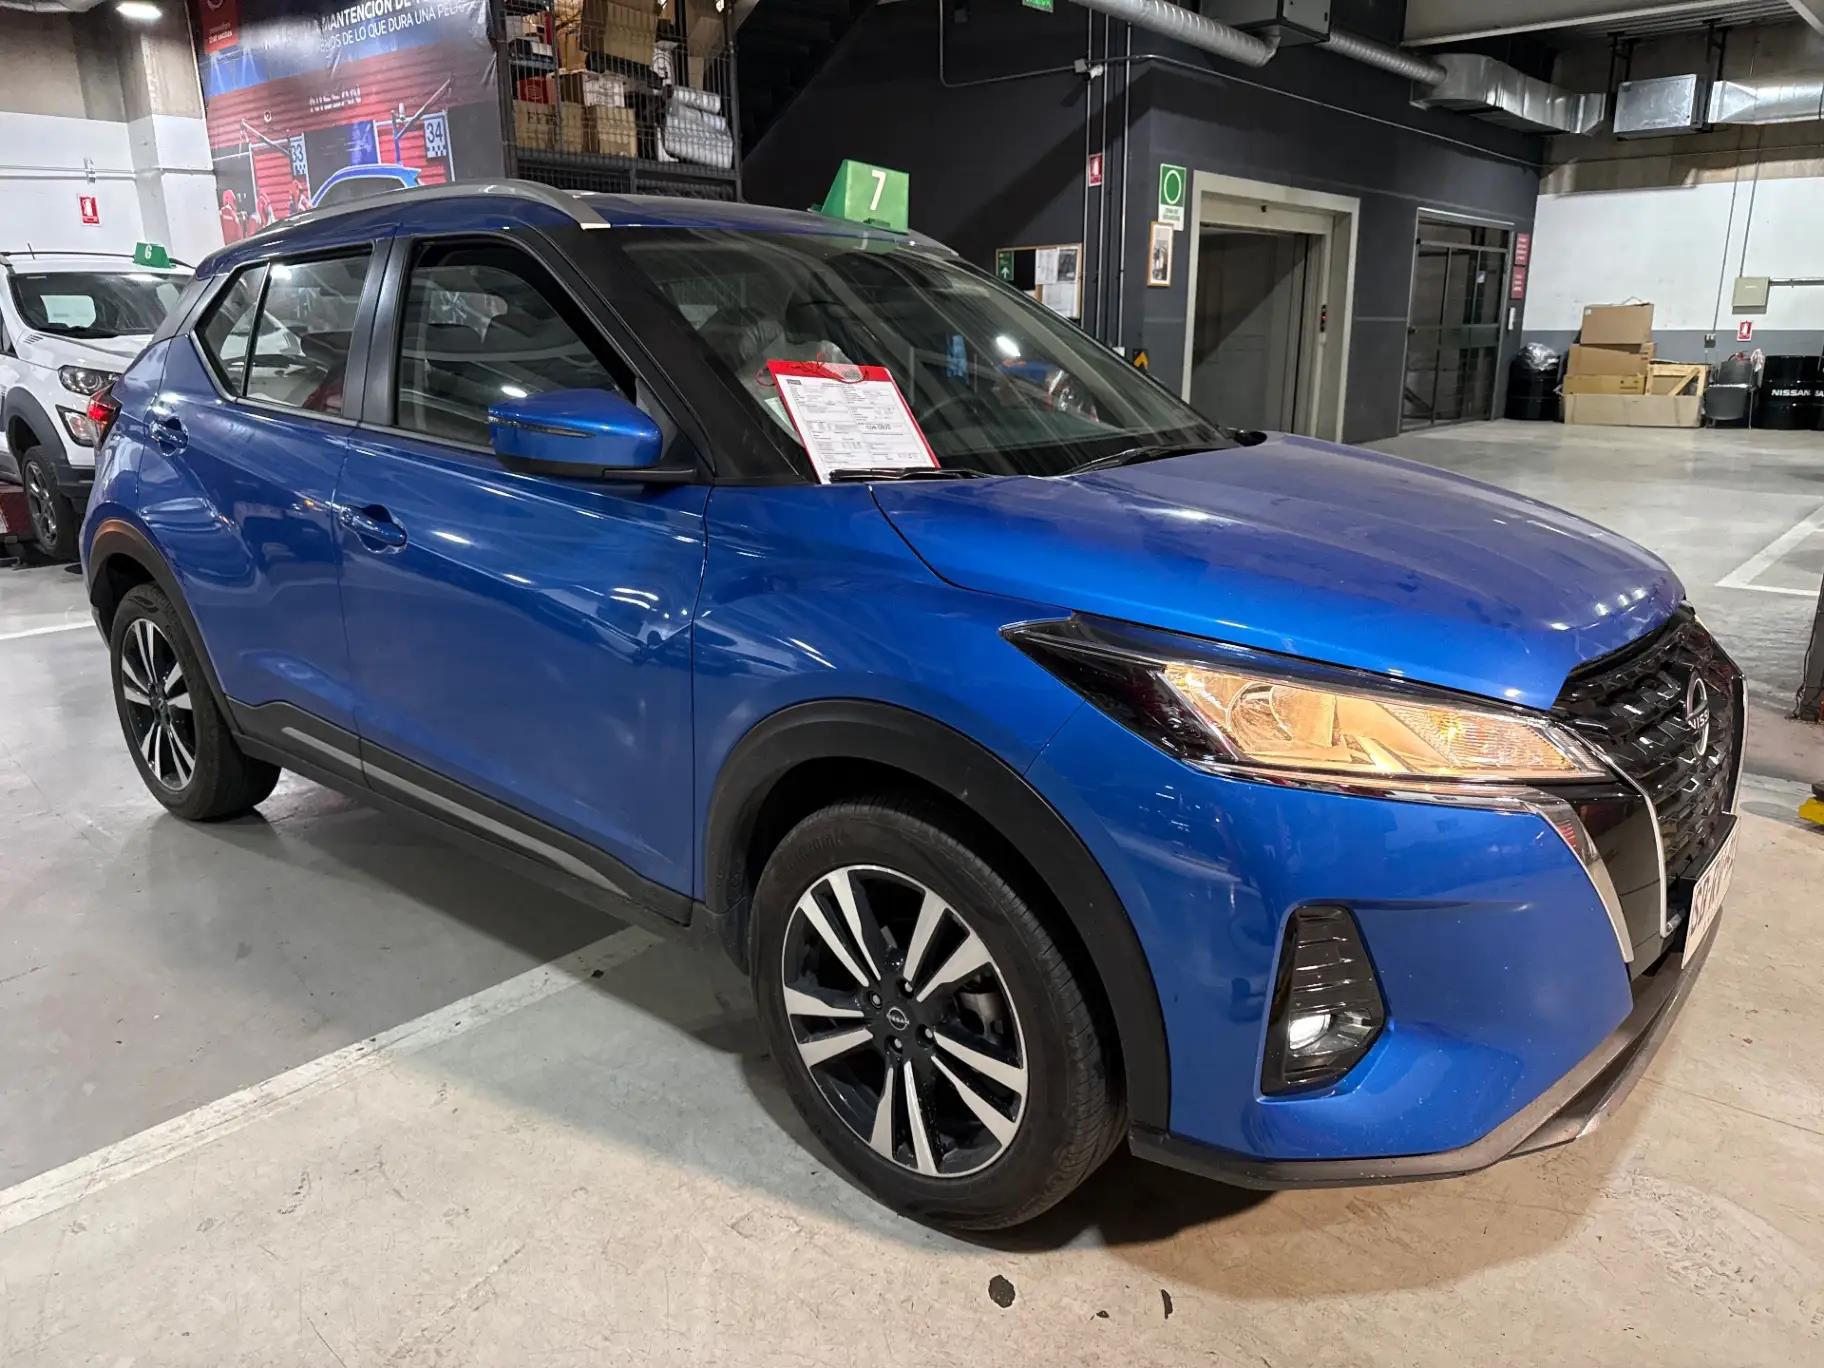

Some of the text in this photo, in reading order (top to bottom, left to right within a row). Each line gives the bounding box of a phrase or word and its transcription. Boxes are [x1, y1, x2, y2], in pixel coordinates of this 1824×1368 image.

[342, 30, 354, 45] DE
[355, 26, 367, 41] LO
[368, 19, 388, 38] QUE
[388, 12, 414, 32] DURA
[414, 6, 437, 25] UNA
[426, 120, 443, 143] 34
[869, 169, 887, 211] 7
[144, 243, 153, 260] 6
[1771, 388, 1811, 397] NISSAN
